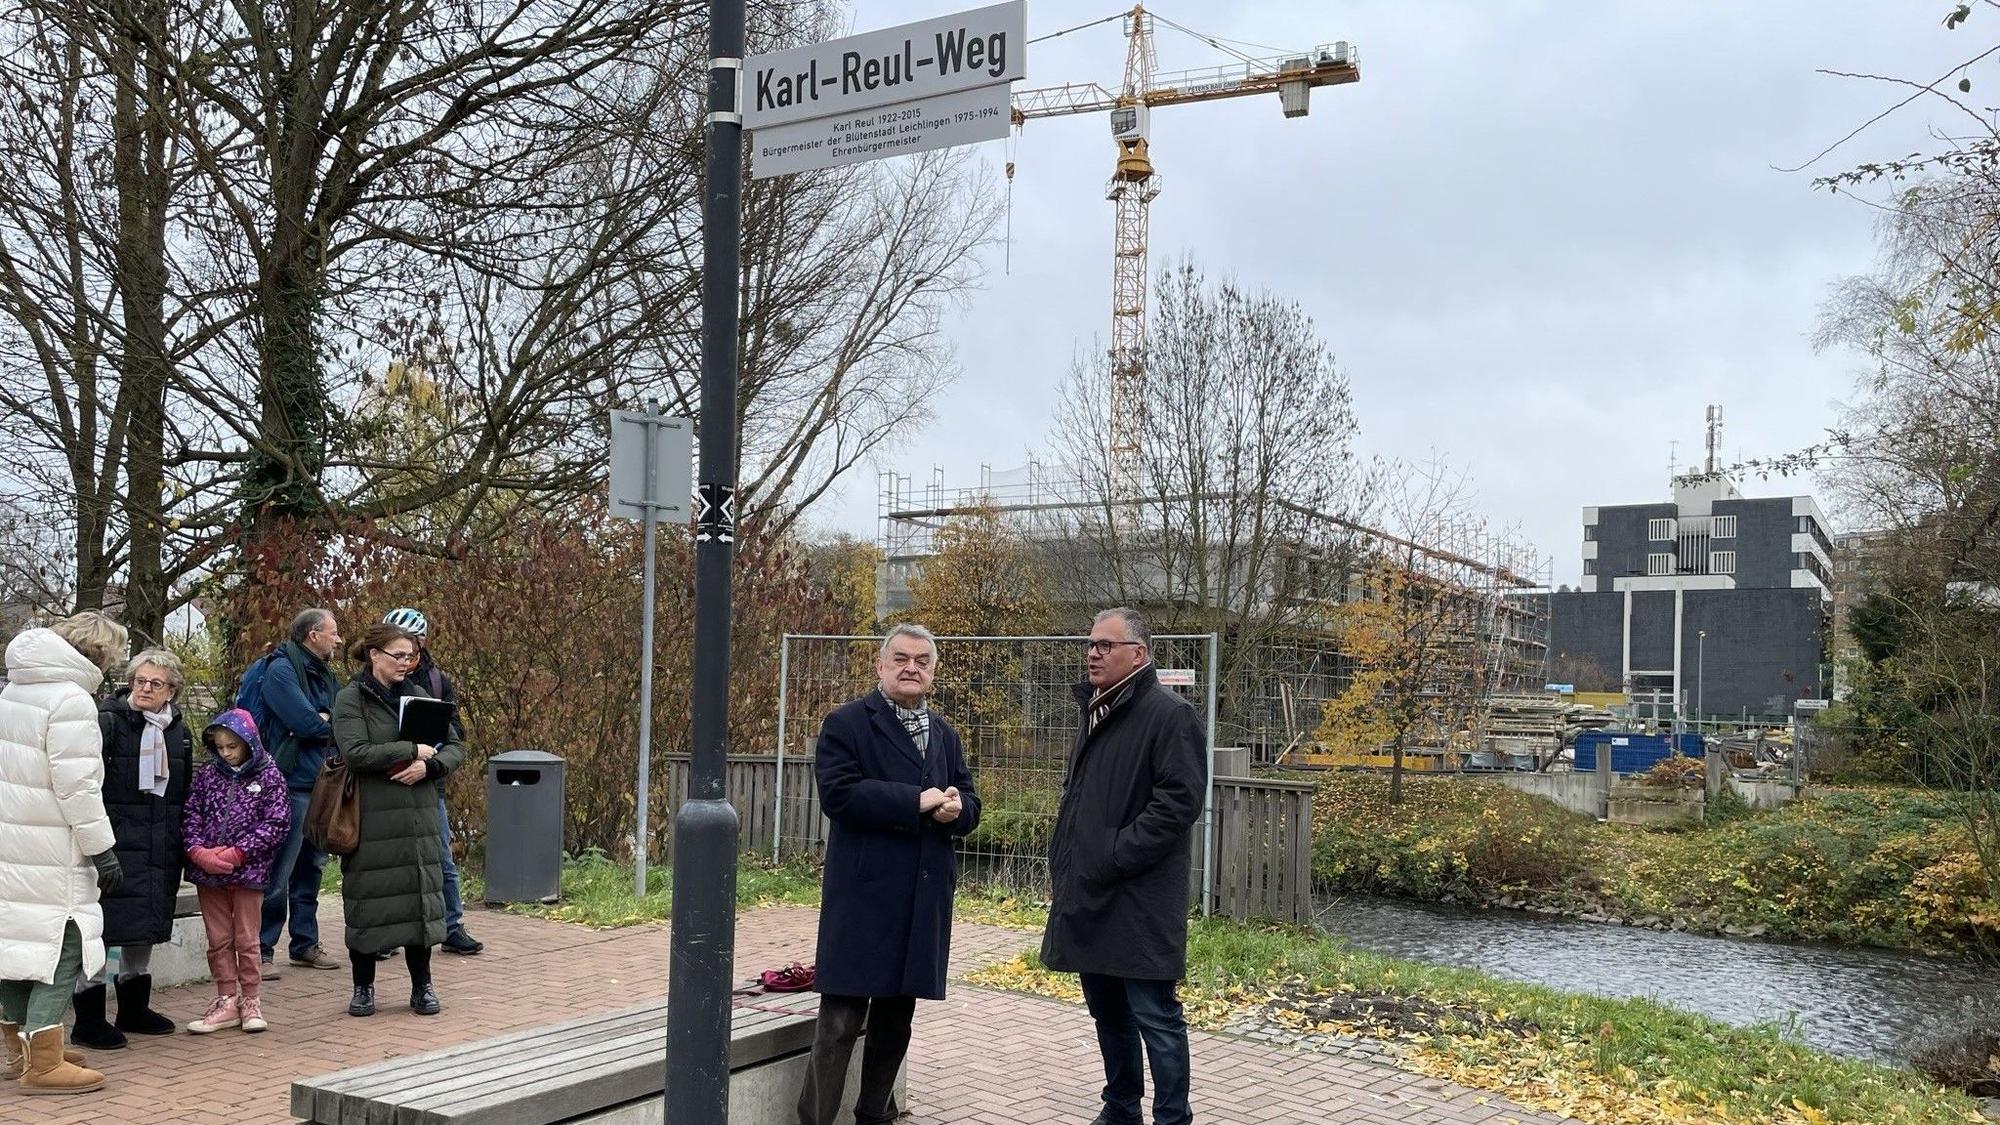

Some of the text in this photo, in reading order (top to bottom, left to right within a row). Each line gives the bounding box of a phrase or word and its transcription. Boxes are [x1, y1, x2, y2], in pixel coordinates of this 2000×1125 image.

[757, 27, 1006, 112] Karl-Reul-Weg
[762, 106, 999, 157] Bürgermeister der Blütenstadt Leichlingen 1975-1994
[833, 108, 921, 133] Karl Reul 1922-2015
[832, 135, 922, 157] Ehrenbürgermeister
